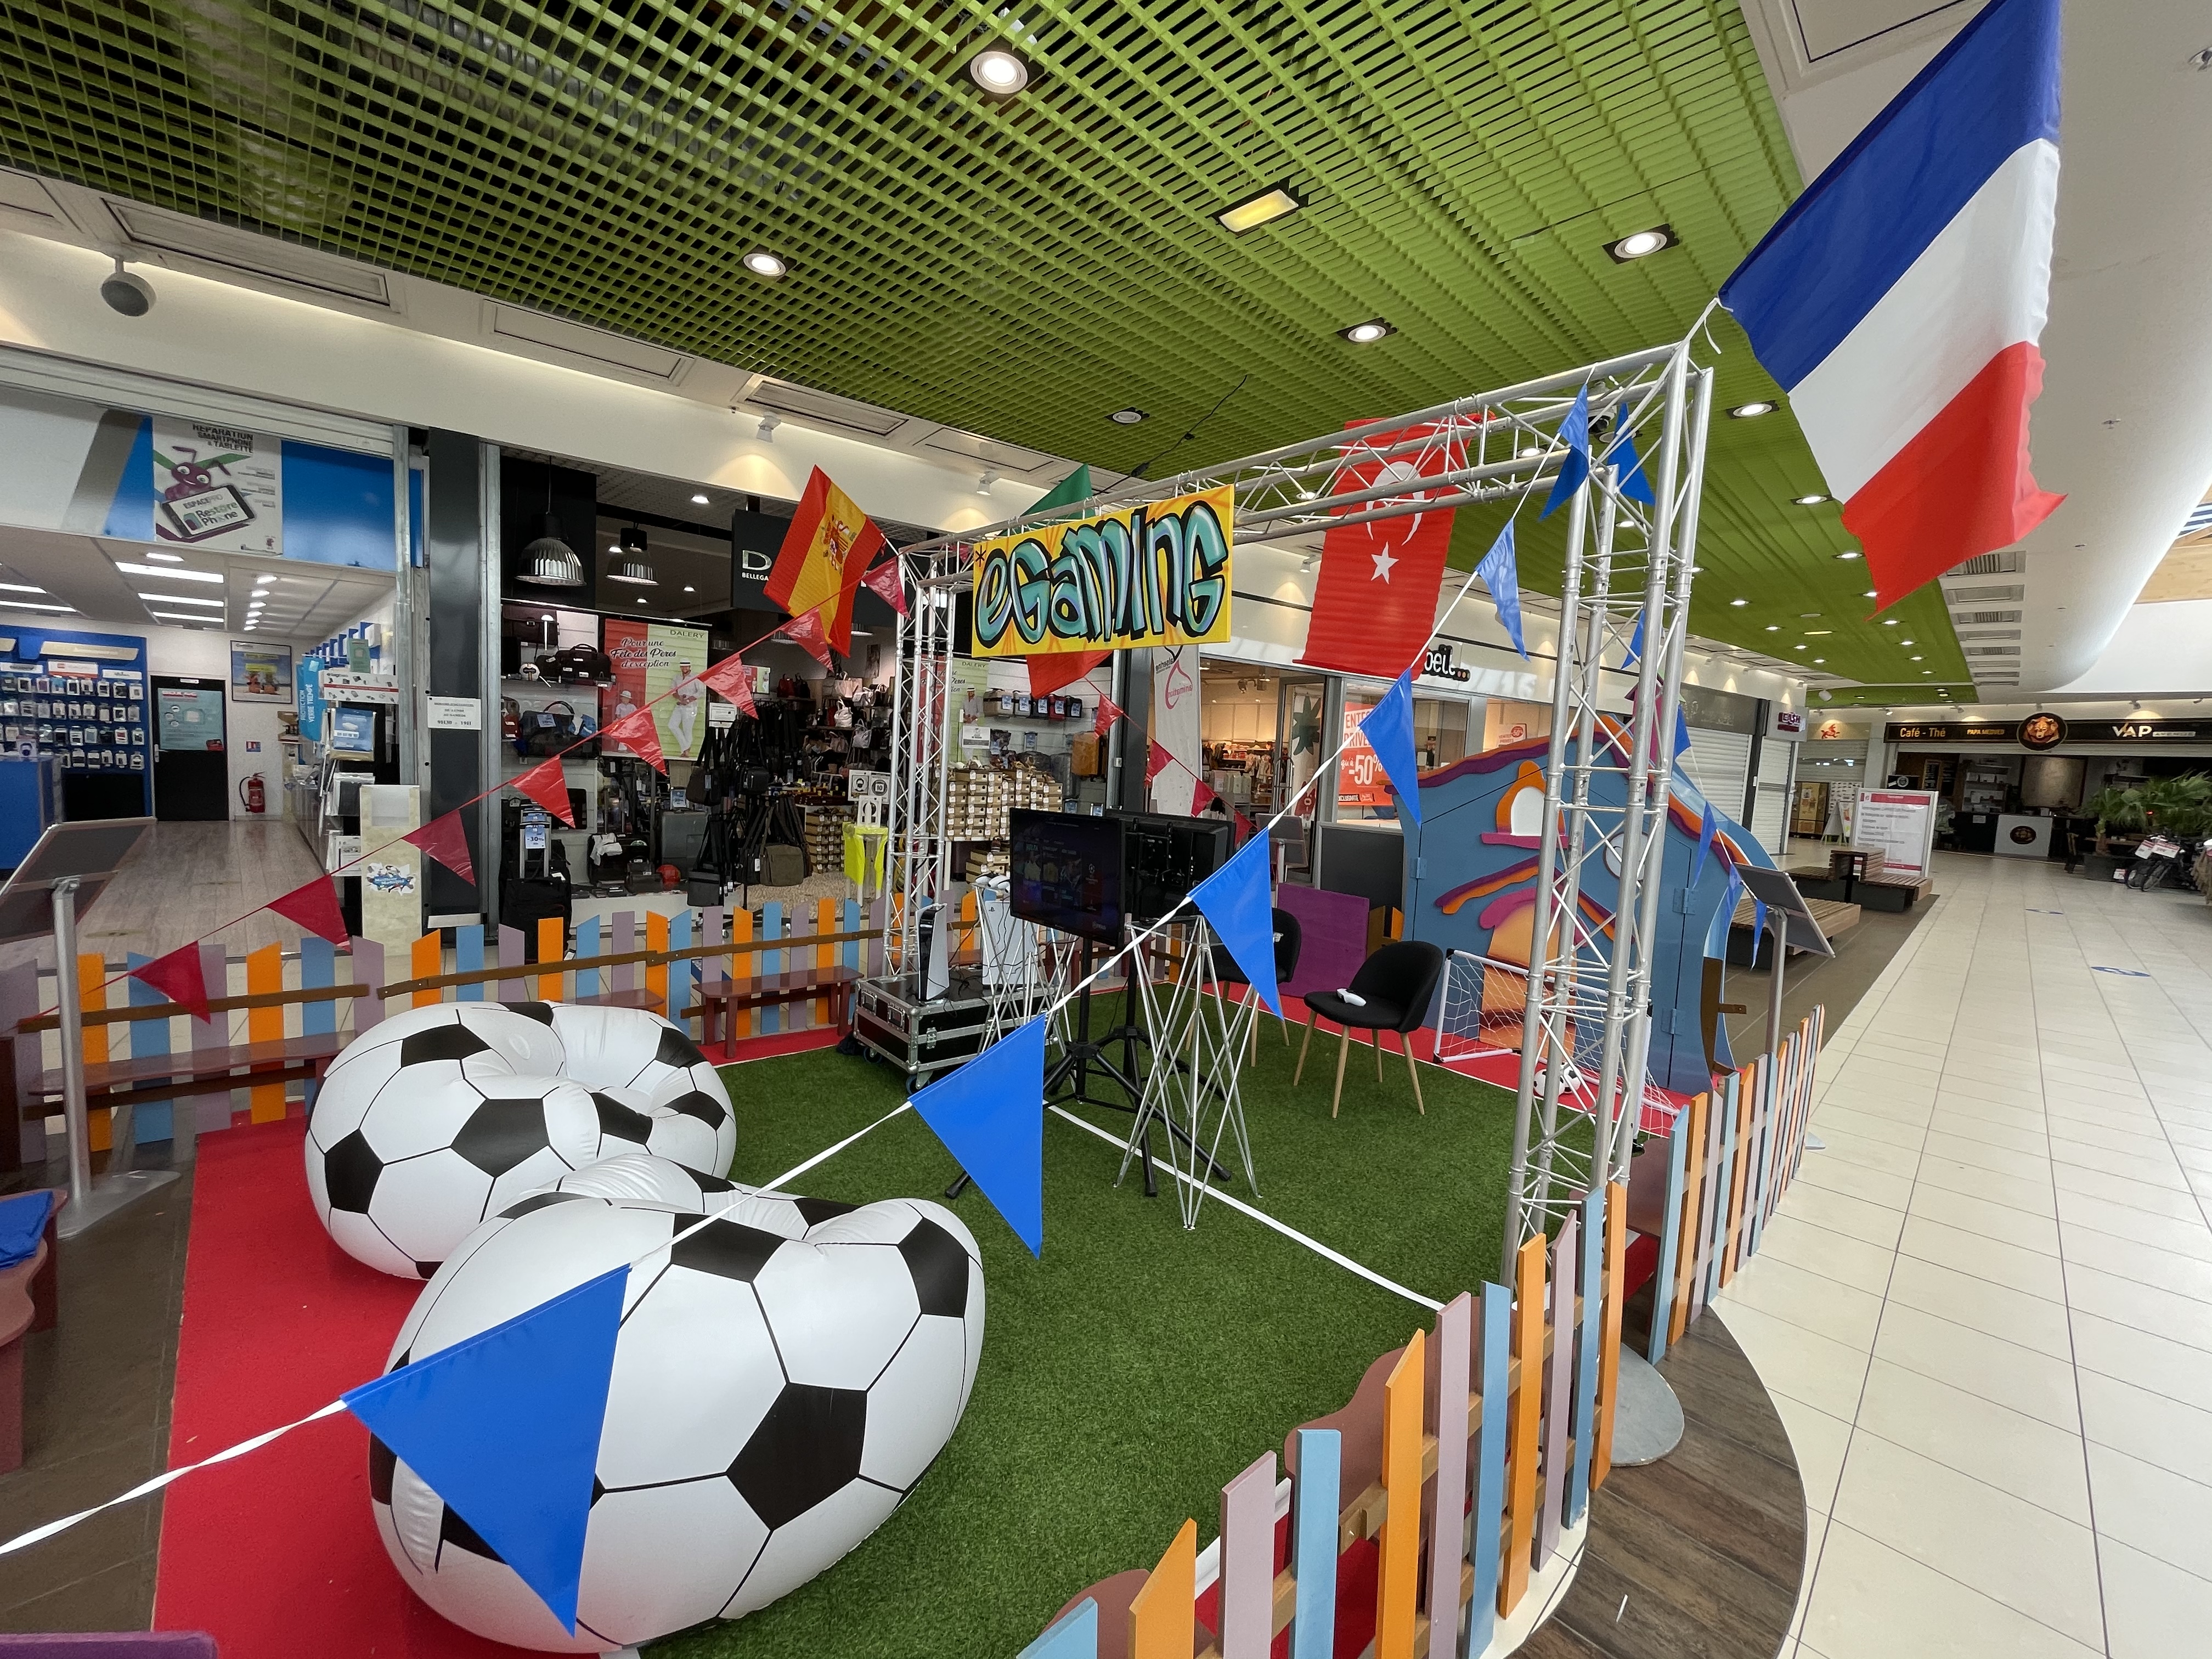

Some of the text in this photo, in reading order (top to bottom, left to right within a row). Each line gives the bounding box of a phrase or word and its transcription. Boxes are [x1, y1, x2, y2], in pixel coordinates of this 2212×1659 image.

[198, 432, 253, 449] SMARTPHONE
[214, 441, 253, 453] TABLETTE
[195, 502, 239, 518] Restore
[742, 572, 769, 581] BELLEGA
[670, 630, 705, 639] DALERY
[621, 638, 647, 647] Pour
[634, 648, 648, 657] des
[621, 659, 669, 669] d'exception
[1900, 727, 1920, 737] Café
[1929, 727, 1946, 737] Thé
[1348, 754, 1383, 785] -50%
